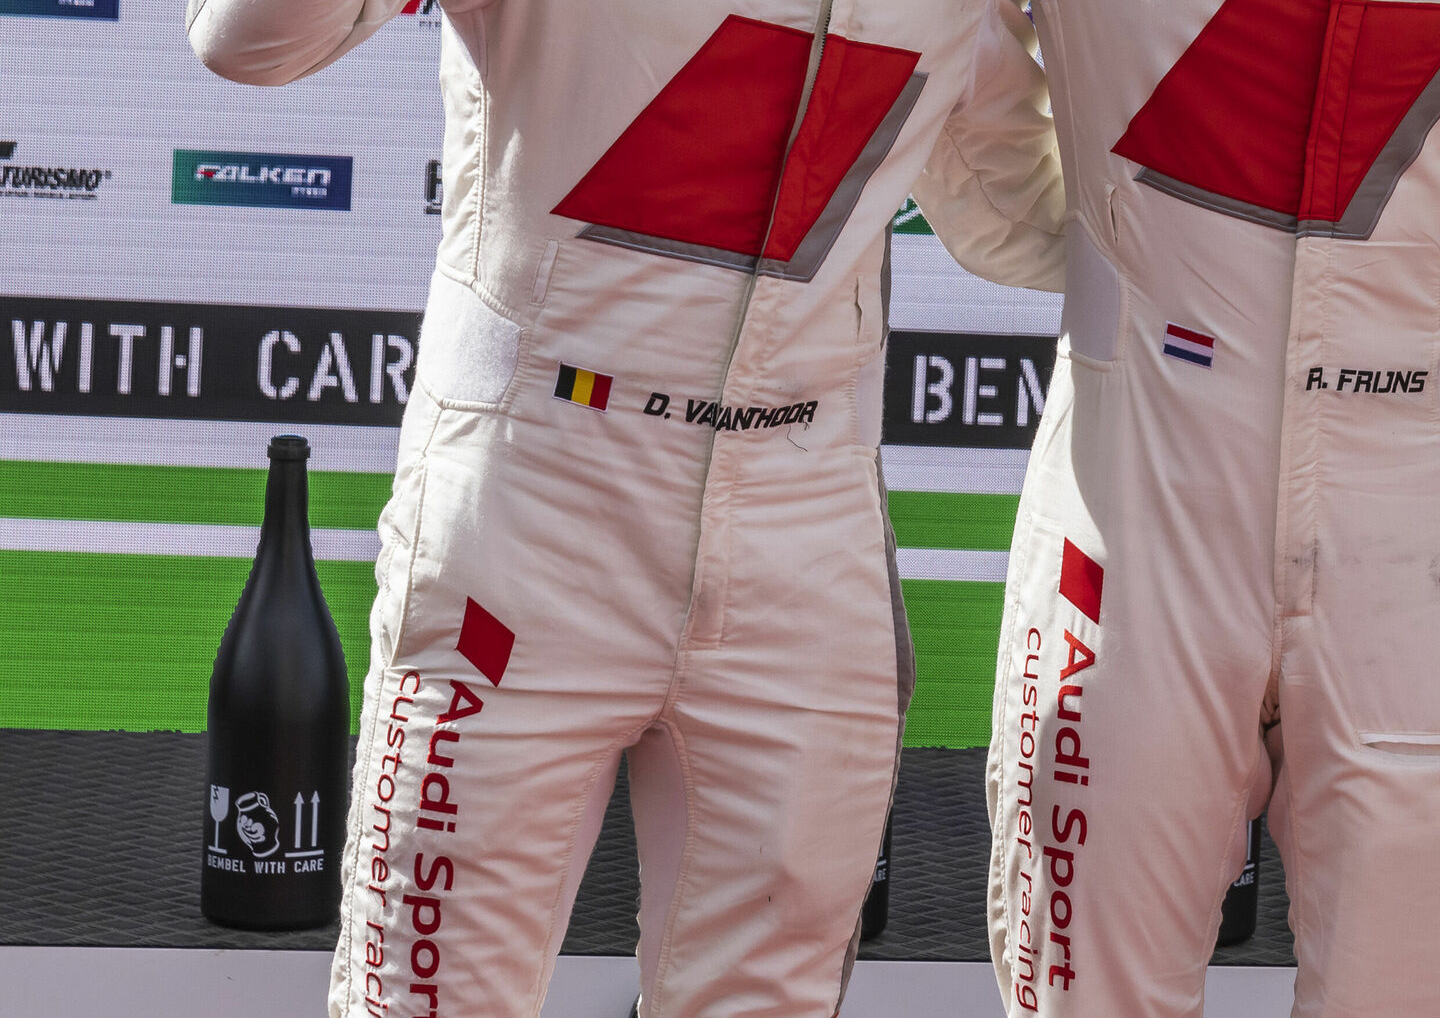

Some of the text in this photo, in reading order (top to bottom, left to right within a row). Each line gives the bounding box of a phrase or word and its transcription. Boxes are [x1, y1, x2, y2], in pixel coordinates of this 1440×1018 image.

[195, 163, 332, 187] FALKEN
[11, 319, 203, 399] WITH
[1336, 368, 1430, 394] FRIJNS
[643, 391, 671, 420] D.
[368, 669, 420, 908] customer
[416, 678, 484, 834] Audi
[1016, 626, 1043, 1013] customer racing
[1043, 628, 1096, 992] Audi Sport
[207, 853, 325, 875] BEMBEL WITH CARE
